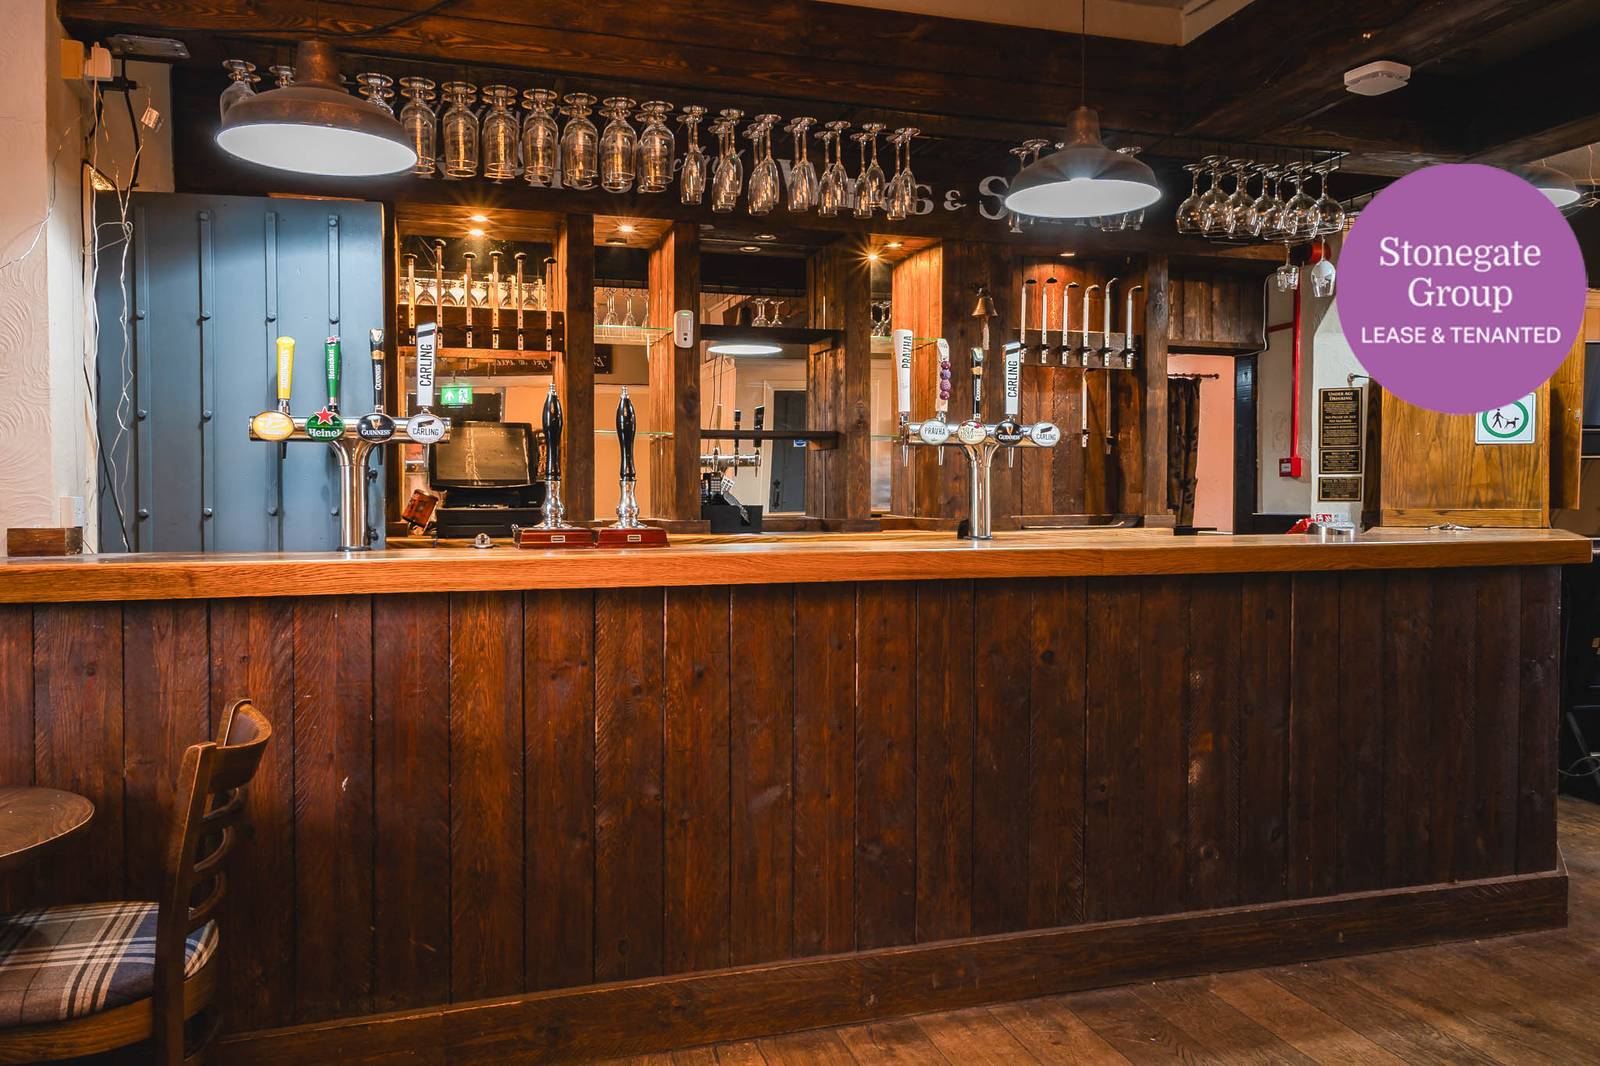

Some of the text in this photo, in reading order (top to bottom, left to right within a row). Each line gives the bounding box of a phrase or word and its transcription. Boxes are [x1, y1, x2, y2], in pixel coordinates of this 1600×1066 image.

[901, 335, 912, 369] PRAVHA
[419, 343, 433, 387] CARLING
[1008, 360, 1018, 398] CARLING
[361, 429, 391, 437] GUINNESS
[412, 426, 440, 437] CARLING
[924, 426, 946, 436] PRAVHA
[1035, 433, 1057, 441] CARLING
